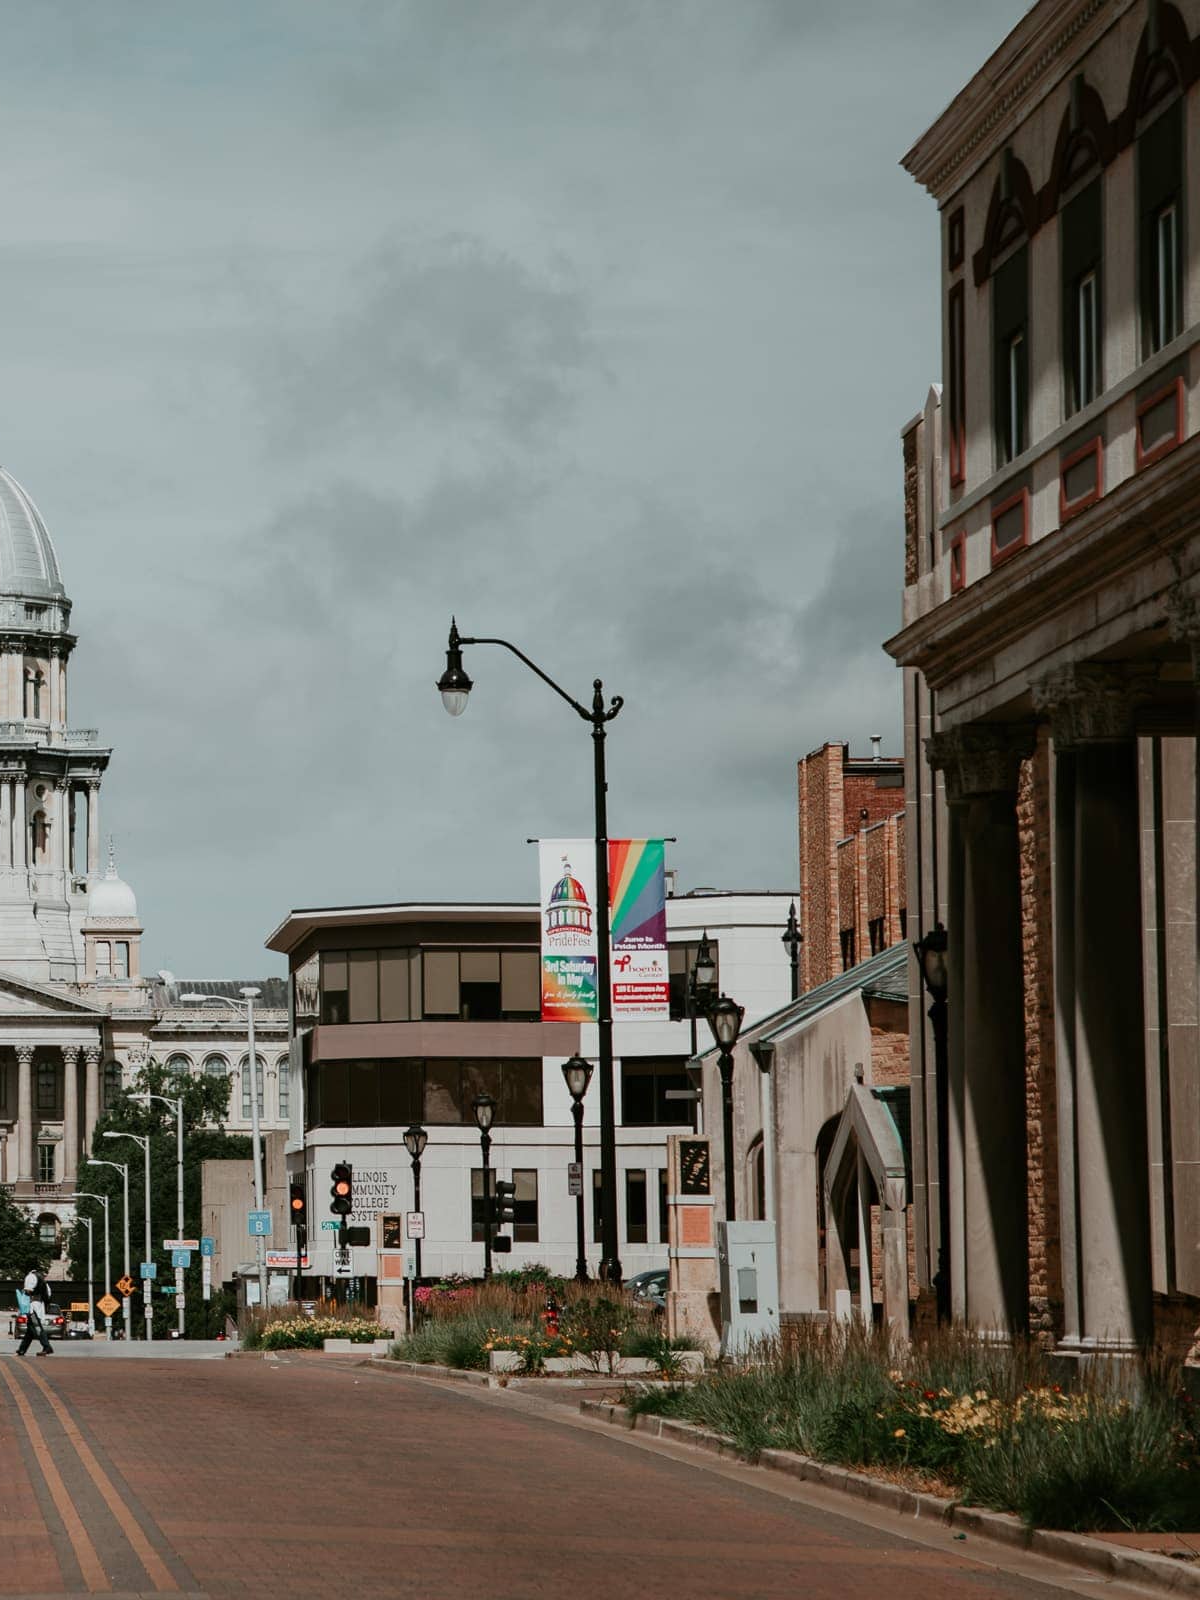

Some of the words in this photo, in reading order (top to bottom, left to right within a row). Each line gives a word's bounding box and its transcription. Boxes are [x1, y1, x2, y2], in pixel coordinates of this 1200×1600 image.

[548, 933, 591, 947] PrideFest
[544, 960, 559, 973] 3rd
[560, 960, 595, 976] Saturday
[566, 973, 584, 988] May
[352, 1171, 388, 1183] LLINOIS
[352, 1184, 397, 1196] MMUNITY
[352, 1197, 389, 1209] OLLEGE
[351, 1210, 379, 1222] SYSTE
[255, 1221, 263, 1233] B
[321, 1221, 334, 1231] 5th
